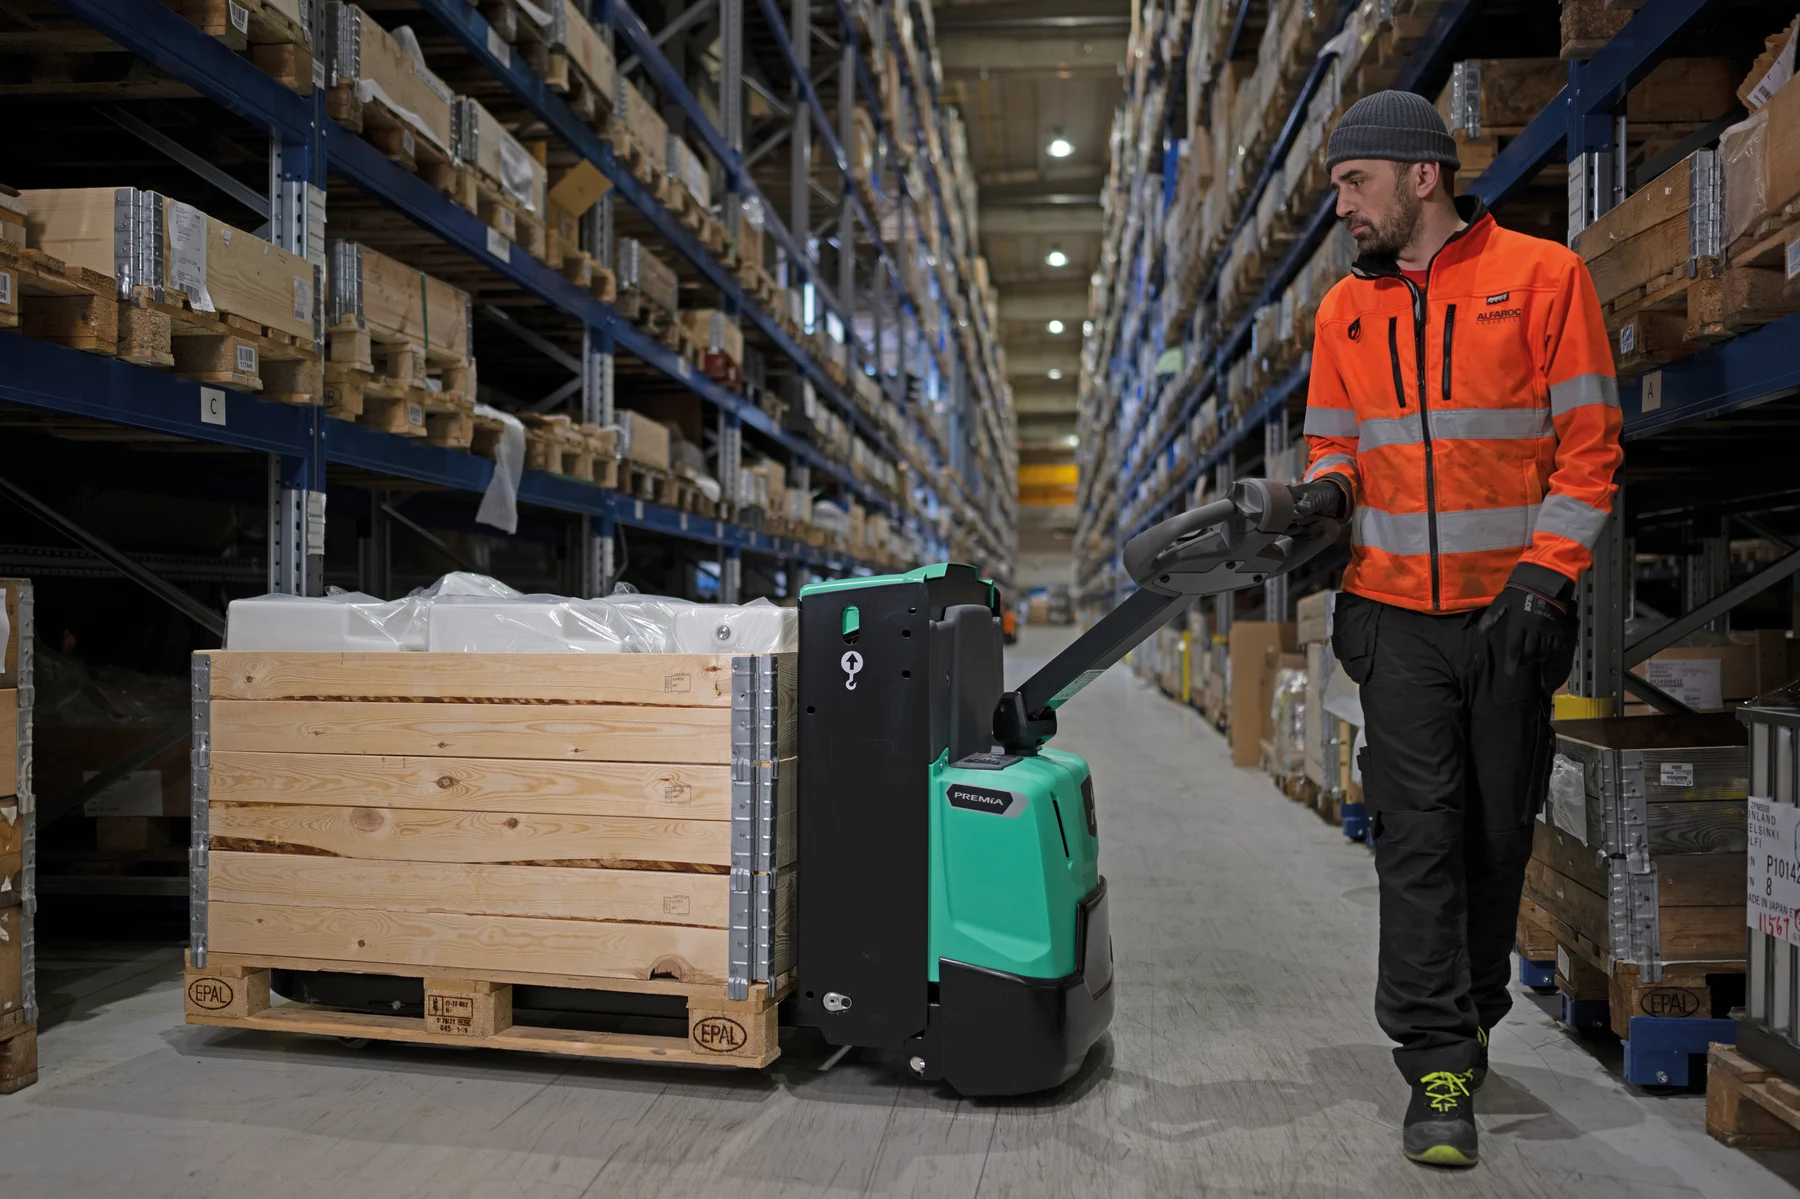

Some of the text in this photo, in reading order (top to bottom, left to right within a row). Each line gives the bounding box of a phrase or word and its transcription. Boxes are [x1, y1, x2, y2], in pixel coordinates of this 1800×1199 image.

[1477, 308, 1522, 320] ALFAROC
[1647, 381, 1654, 400] A
[210, 398, 217, 415] C
[1748, 810, 1777, 826] INLAND
[1749, 822, 1779, 840] ELSINKI
[1766, 877, 1772, 896] 8
[1748, 893, 1760, 906] ADE
[1761, 897, 1768, 909] IN
[1768, 900, 1788, 916] JAPAN
[195, 984, 227, 1003] EPAL
[1651, 994, 1690, 1013] EPAL
[701, 1023, 739, 1046] EPAL
